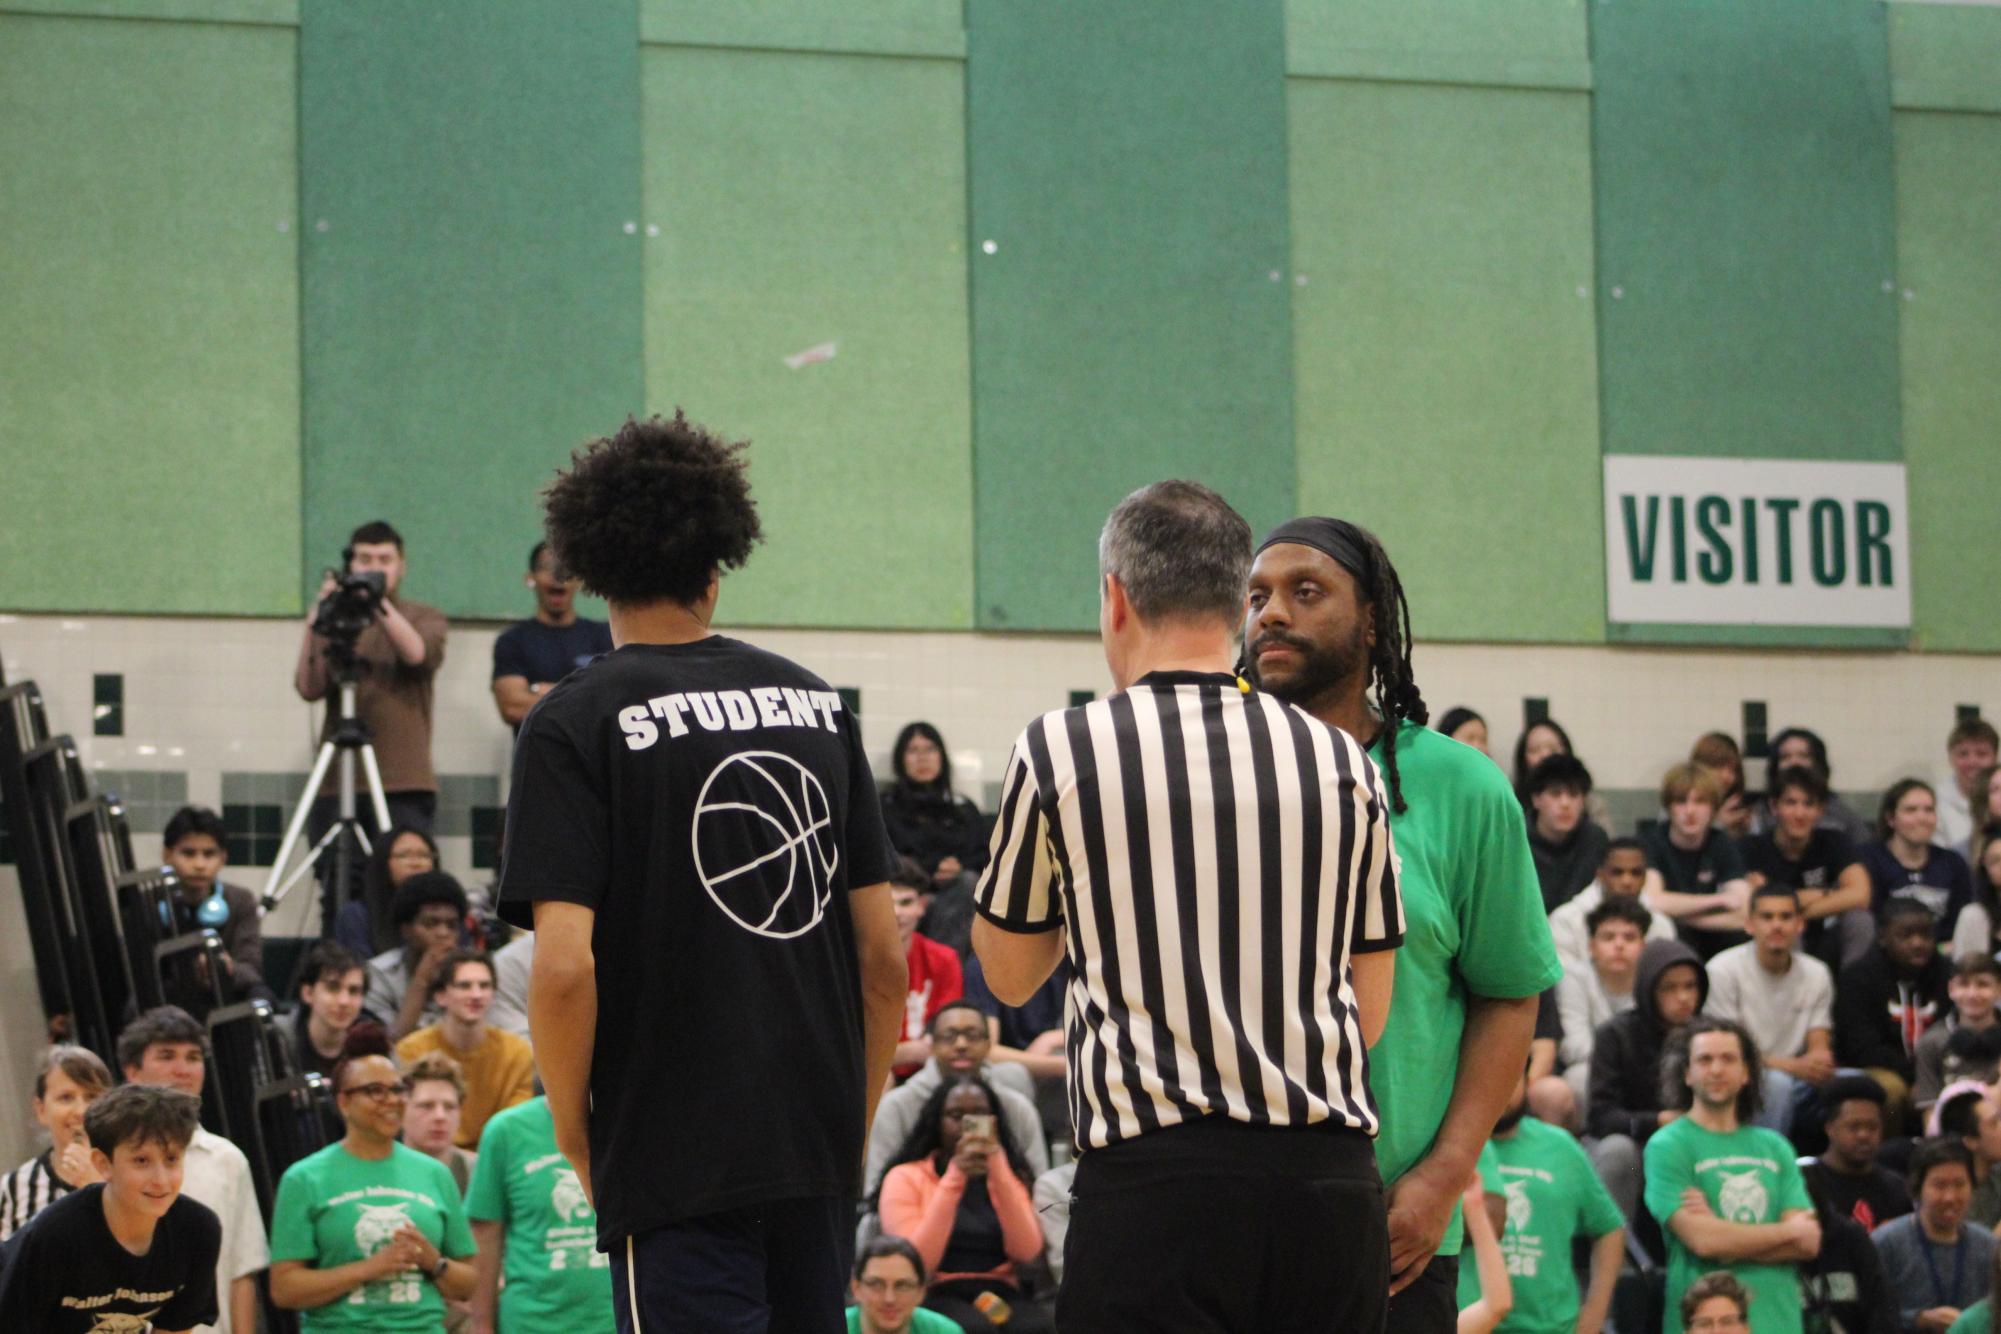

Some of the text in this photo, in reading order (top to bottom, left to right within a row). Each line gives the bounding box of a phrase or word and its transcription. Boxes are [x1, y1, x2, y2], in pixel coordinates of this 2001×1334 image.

[1620, 494, 1893, 586] VISITOR
[618, 686, 842, 750] STUDENT
[62, 1294, 113, 1309] Walter
